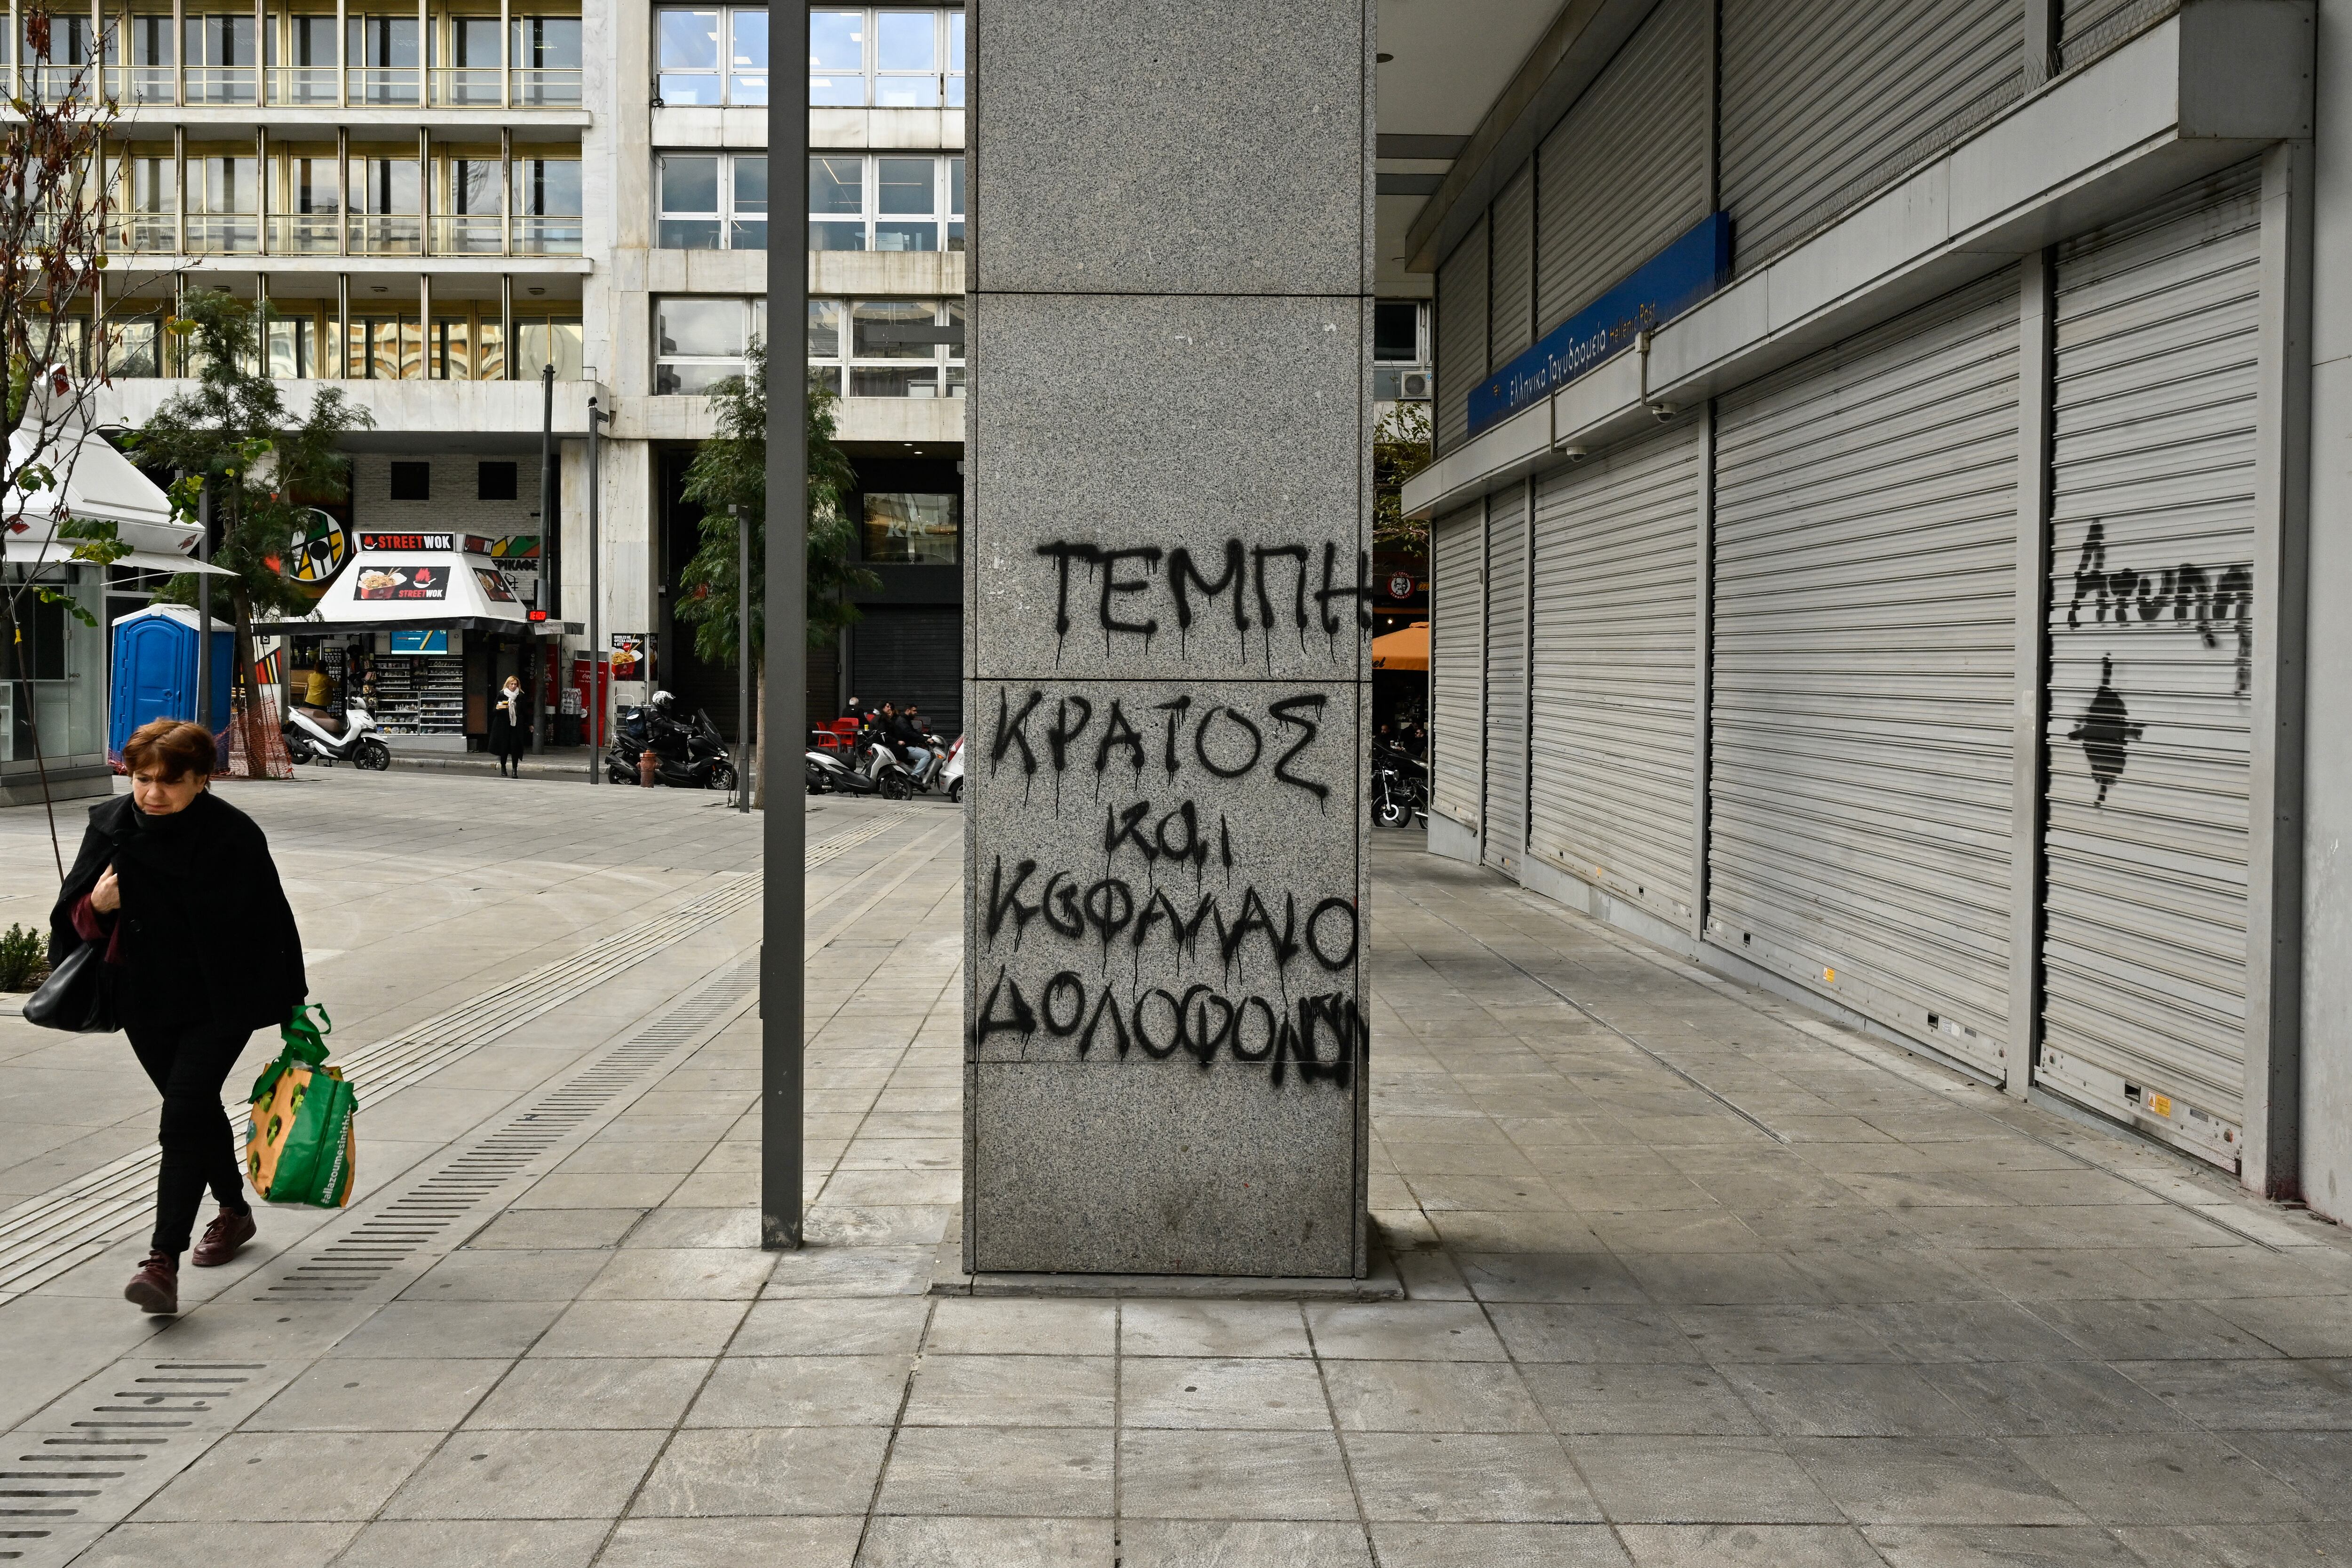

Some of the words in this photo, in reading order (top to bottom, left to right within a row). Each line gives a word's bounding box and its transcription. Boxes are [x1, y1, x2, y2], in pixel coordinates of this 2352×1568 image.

[1510, 358, 1546, 407] Ελληνικά
[1549, 321, 1606, 384] Ταχυδρομεία
[1609, 310, 1637, 345] Hellenic
[1639, 297, 1655, 327] Post
[1037, 538, 1372, 645] ΤΕΜΠΗ
[991, 686, 1329, 801] ΚΡΑΤΟΣ
